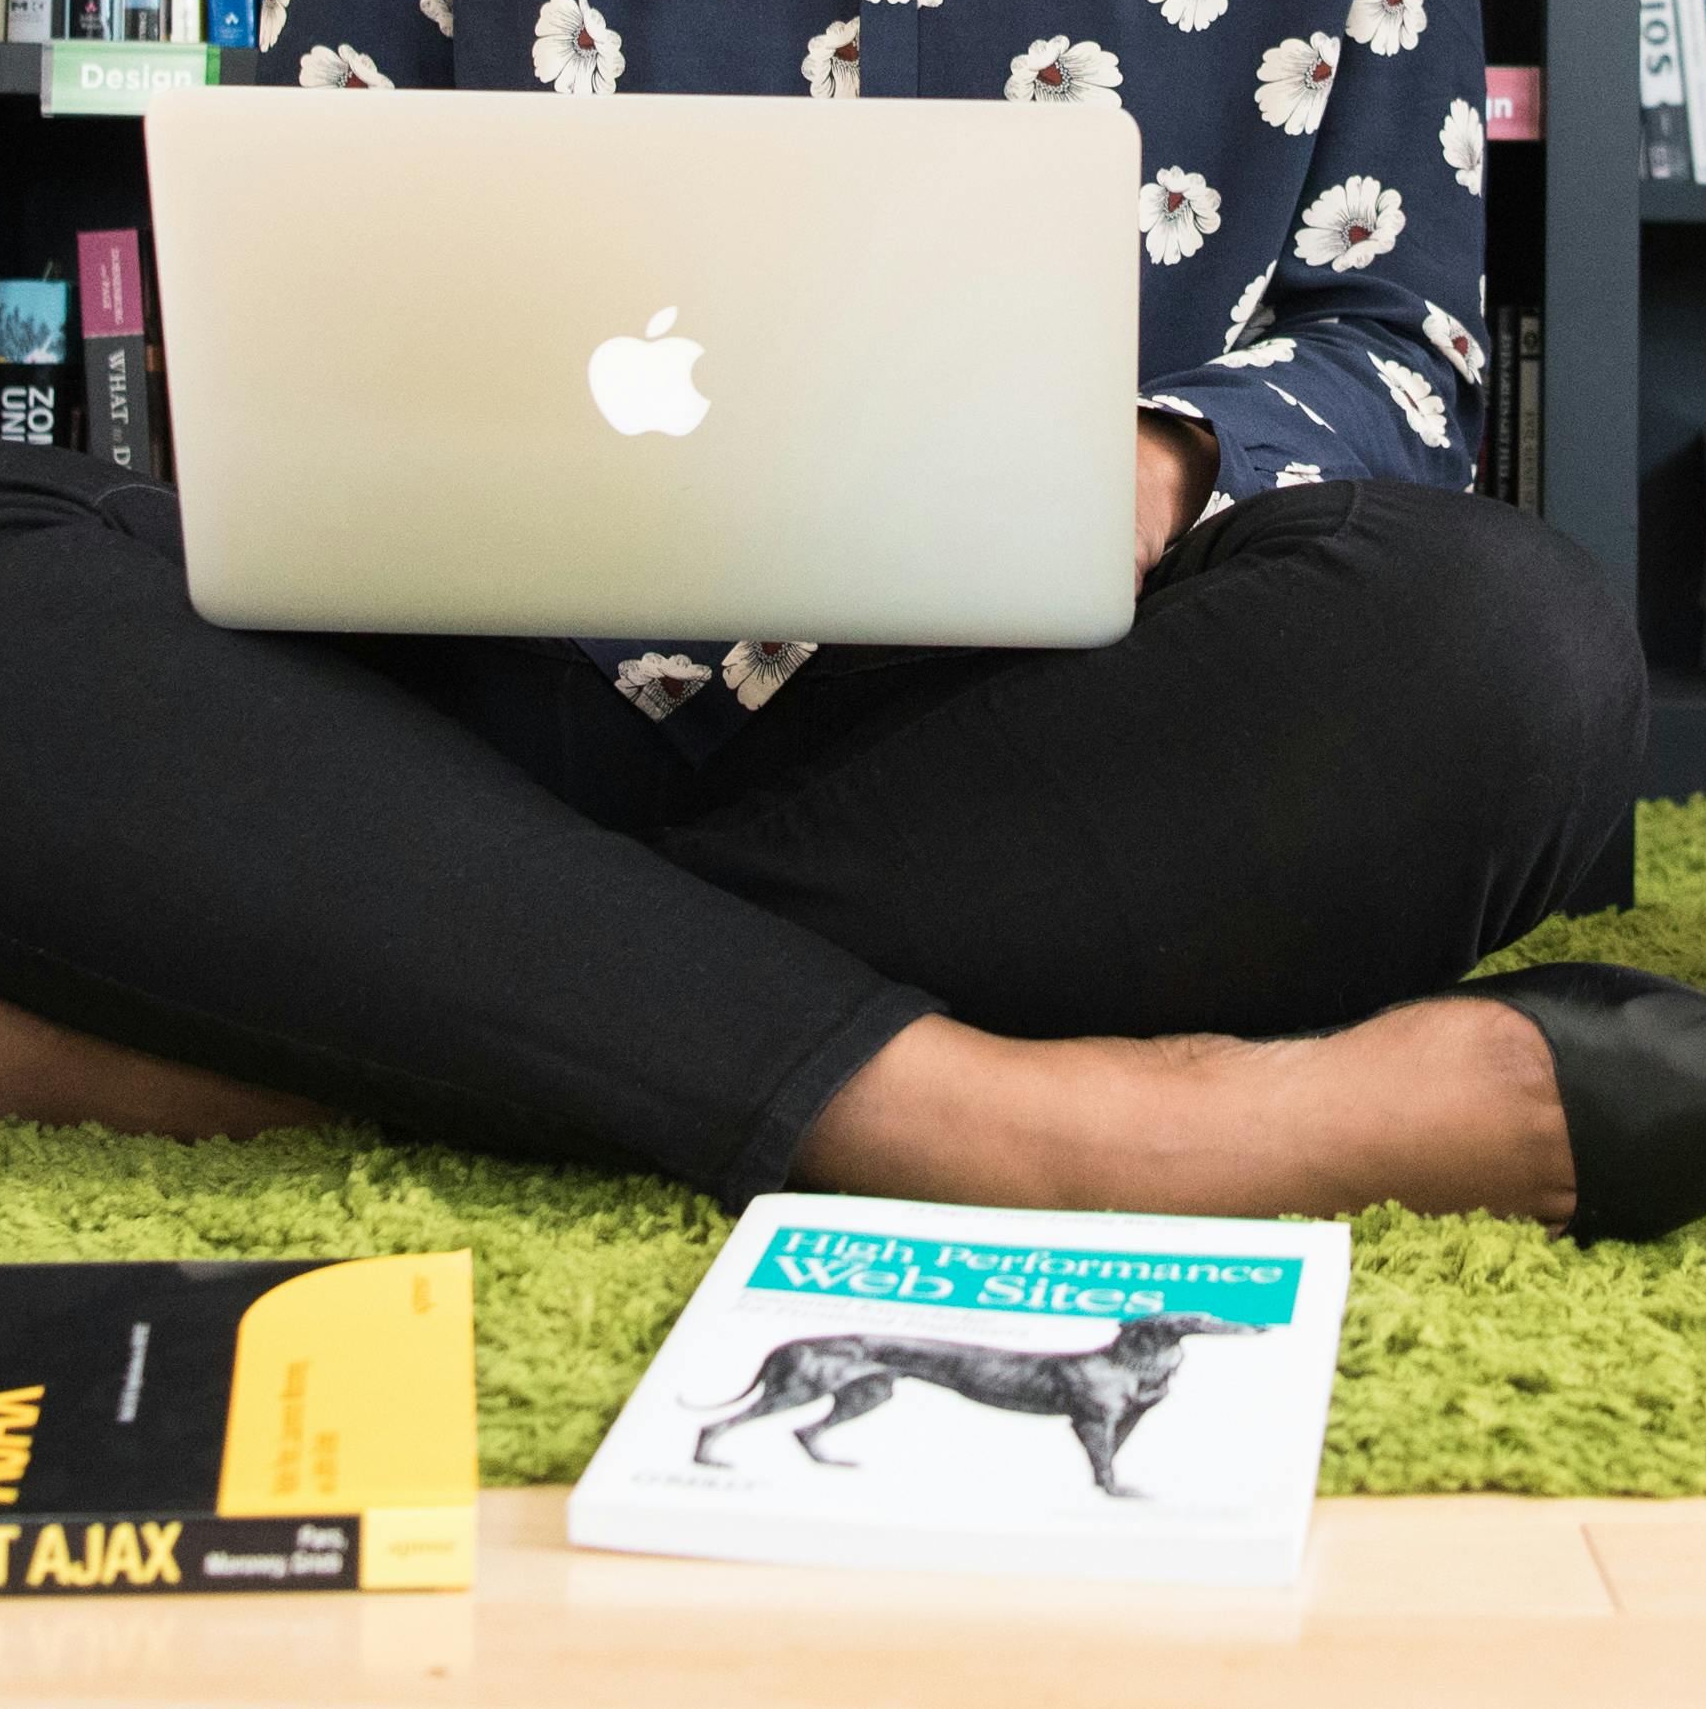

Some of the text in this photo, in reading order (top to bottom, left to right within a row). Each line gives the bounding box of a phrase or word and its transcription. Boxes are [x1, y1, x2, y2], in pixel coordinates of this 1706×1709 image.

[80, 62, 193, 92] Design
[108, 348, 129, 425] WHAT
[772, 1253, 954, 1303] Web
[977, 1273, 1168, 1316] Sites
[779, 1229, 1285, 1287] High Performance
[24, 1520, 184, 1588] AJAX
